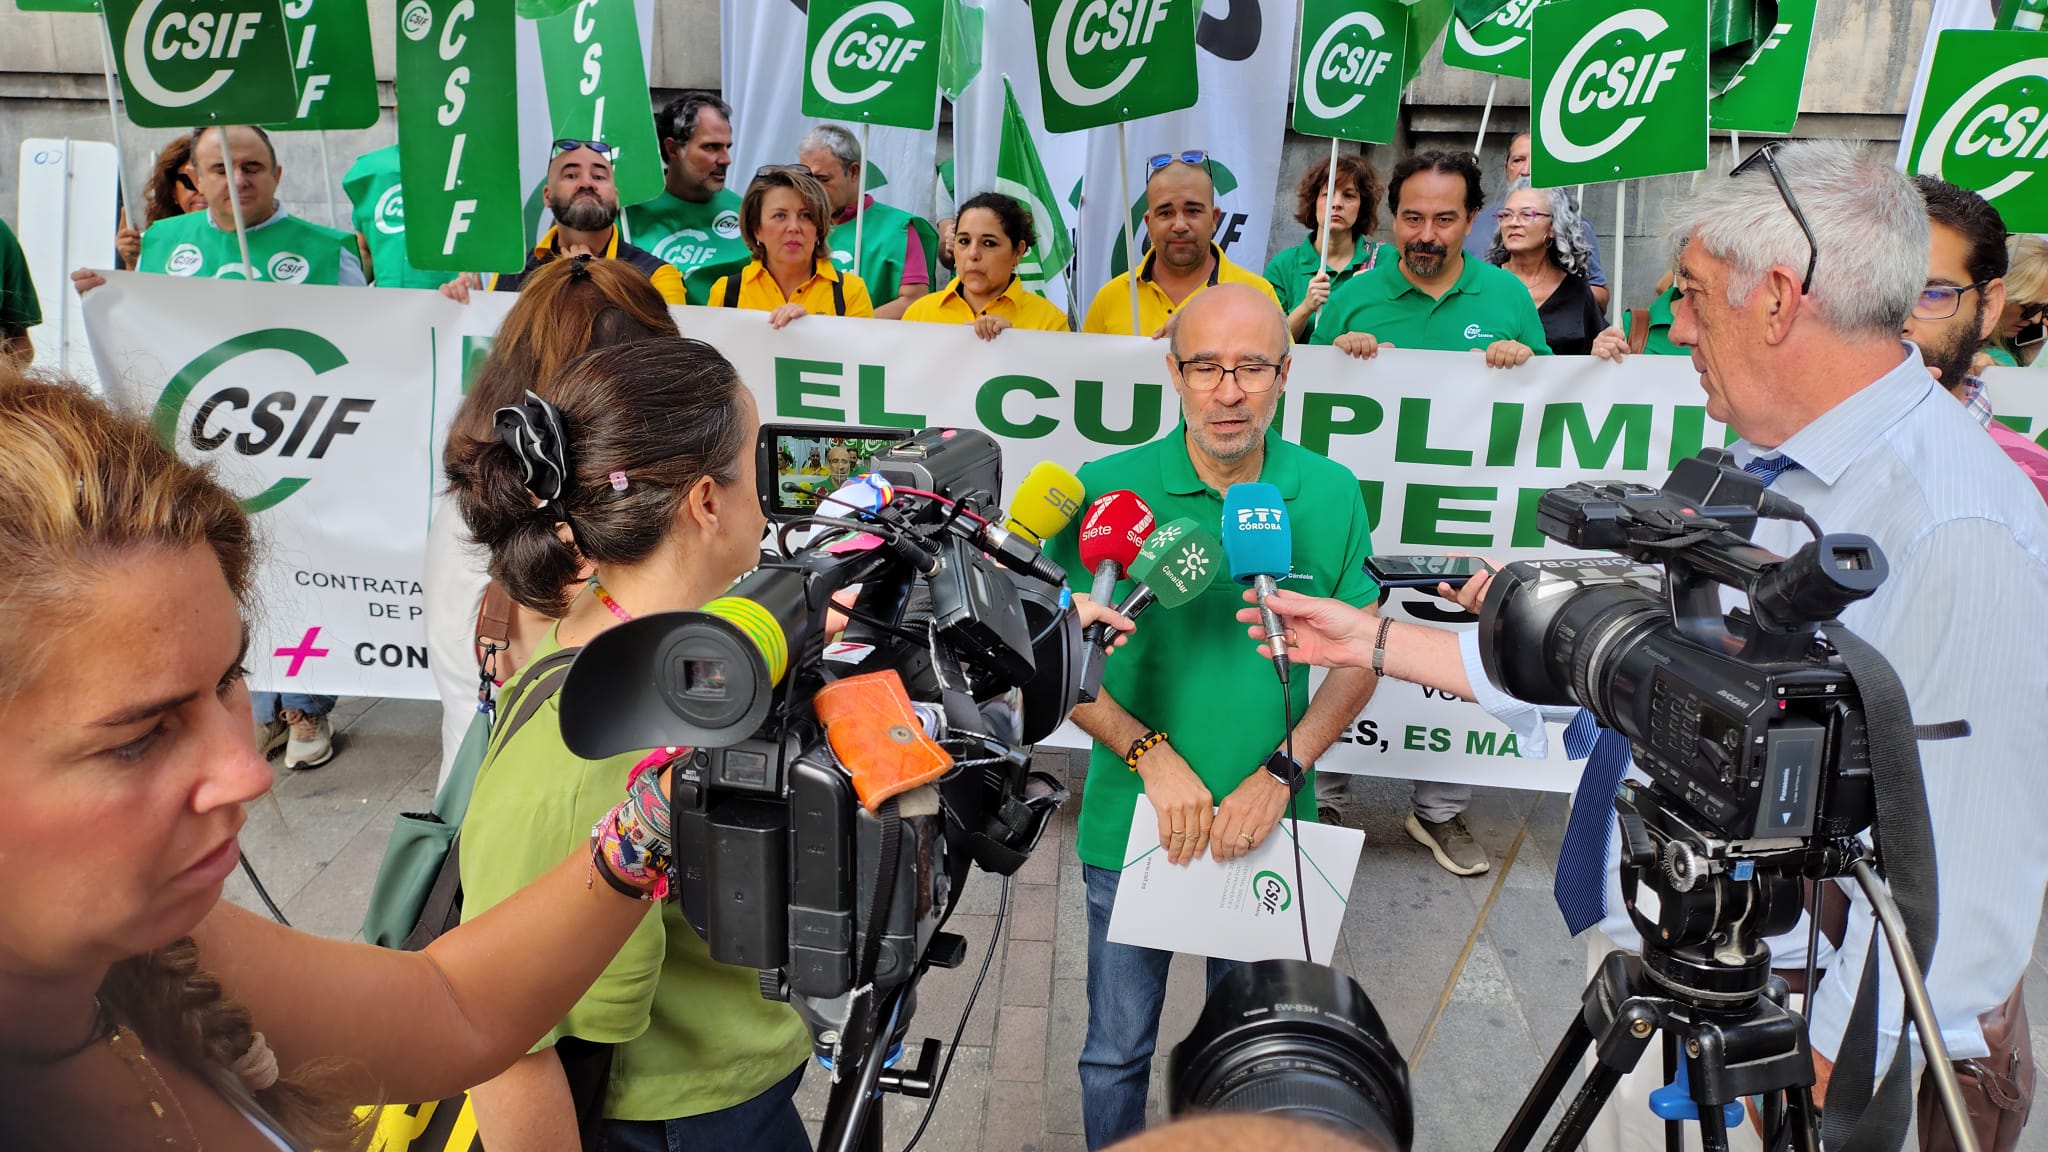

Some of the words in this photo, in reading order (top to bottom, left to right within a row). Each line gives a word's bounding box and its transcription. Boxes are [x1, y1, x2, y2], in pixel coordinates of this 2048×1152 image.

[408, 13, 430, 26] CSIF
[1073, 0, 1172, 56] CSIF
[151, 12, 262, 61] CSIF
[834, 30, 926, 74] CSIF
[1321, 43, 1392, 87] CSIF
[1568, 48, 1686, 114] CSIF
[437, 0, 477, 255] CSIF
[718, 219, 738, 230] CSIF
[663, 243, 717, 265] CSIF
[277, 262, 304, 275] CSIF
[190, 386, 377, 459] CSIF
[775, 356, 927, 429] EL
[975, 374, 1740, 471] CUPLIMI
[1237, 507, 1282, 523] PTV
[1238, 522, 1282, 531] CÓRDOBA
[1126, 530, 1146, 547] sie
[295, 570, 424, 596] CONTRATA
[369, 602, 401, 620] DE
[354, 642, 429, 669] CON
[1404, 725, 1452, 753] ES
[1262, 879, 1281, 916] CSIF
